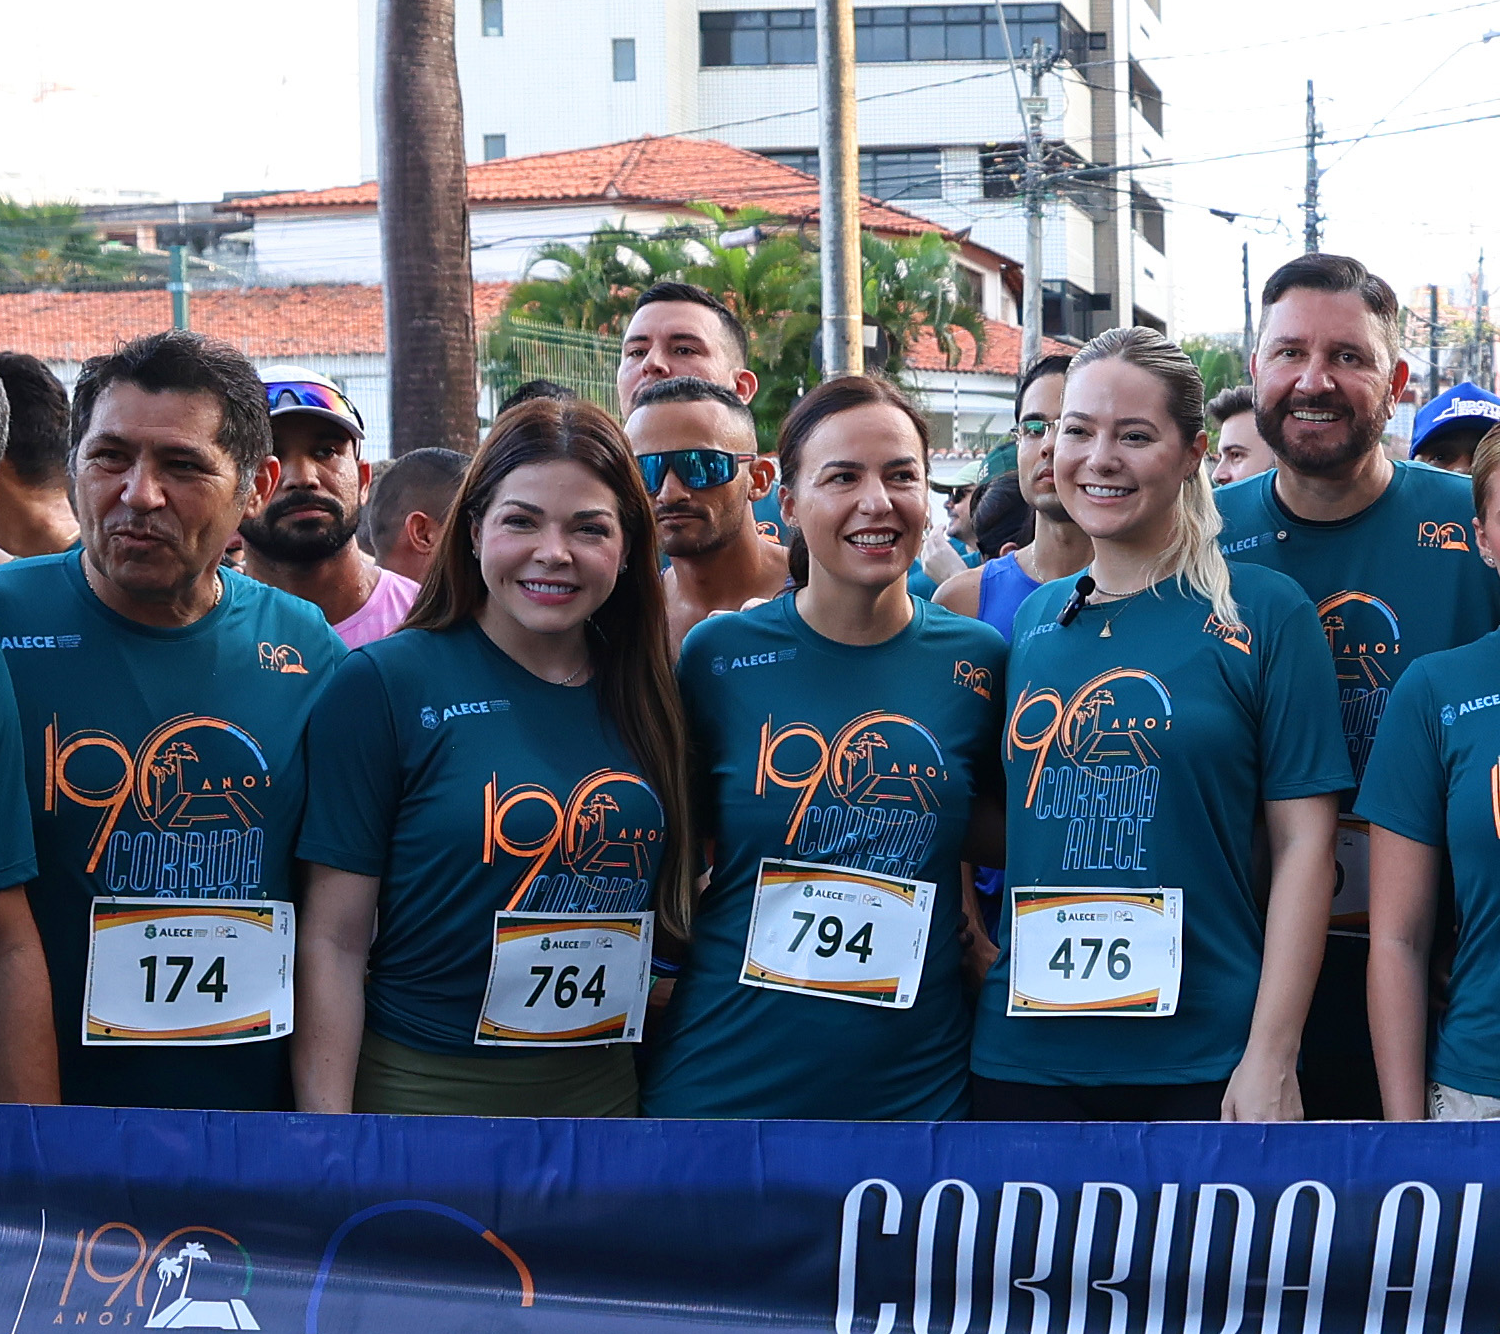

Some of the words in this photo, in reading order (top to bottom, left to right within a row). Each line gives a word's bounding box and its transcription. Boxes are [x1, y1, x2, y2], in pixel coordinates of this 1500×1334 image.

[0, 635, 55, 650] ALECE
[1343, 643, 1400, 654] ANOS
[731, 652, 777, 669] ALECE
[443, 701, 491, 722] ALECE
[1459, 693, 1500, 716] ALECE
[1112, 718, 1172, 731] ANOS
[890, 762, 948, 781] ANOS
[202, 775, 271, 790] ANOS
[1035, 765, 1161, 820] CORRIDA
[798, 805, 938, 863] CORRIDA
[1062, 818, 1152, 871] ALECE
[105, 827, 264, 893] CORRIDA
[814, 889, 843, 902] ALECE
[1068, 913, 1095, 922] ALECE
[159, 929, 193, 939] ALECE
[787, 911, 874, 964] 794
[552, 940, 579, 950] ALECE
[1048, 937, 1132, 980] 476
[139, 956, 228, 1003] 174
[524, 964, 606, 1008] 764
